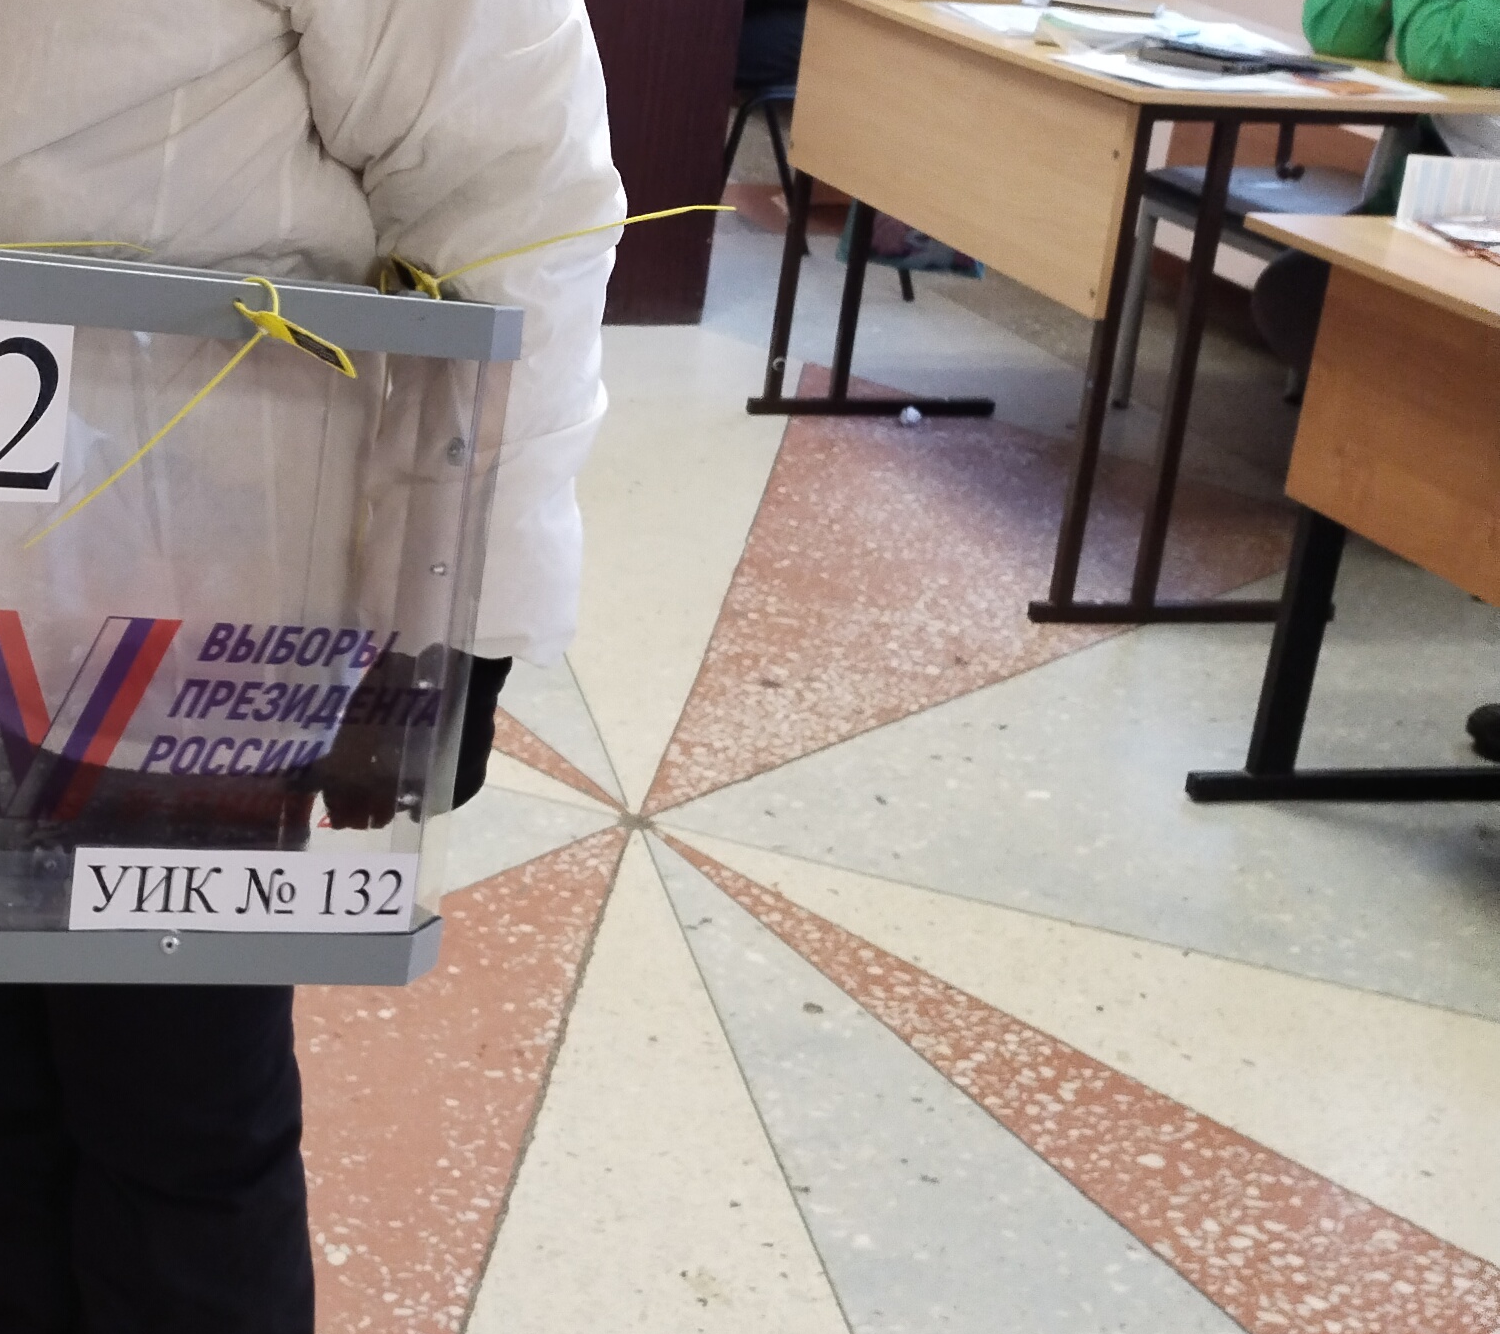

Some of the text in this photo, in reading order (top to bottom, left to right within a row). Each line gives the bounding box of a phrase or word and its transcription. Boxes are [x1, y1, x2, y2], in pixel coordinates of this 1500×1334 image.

[197, 621, 400, 669] ВЫБОРЫ
[167, 678, 443, 730] ПРЕЗИДЕНТА
[139, 734, 324, 777] РОССИИ
[87, 865, 404, 916] УИК № 132
